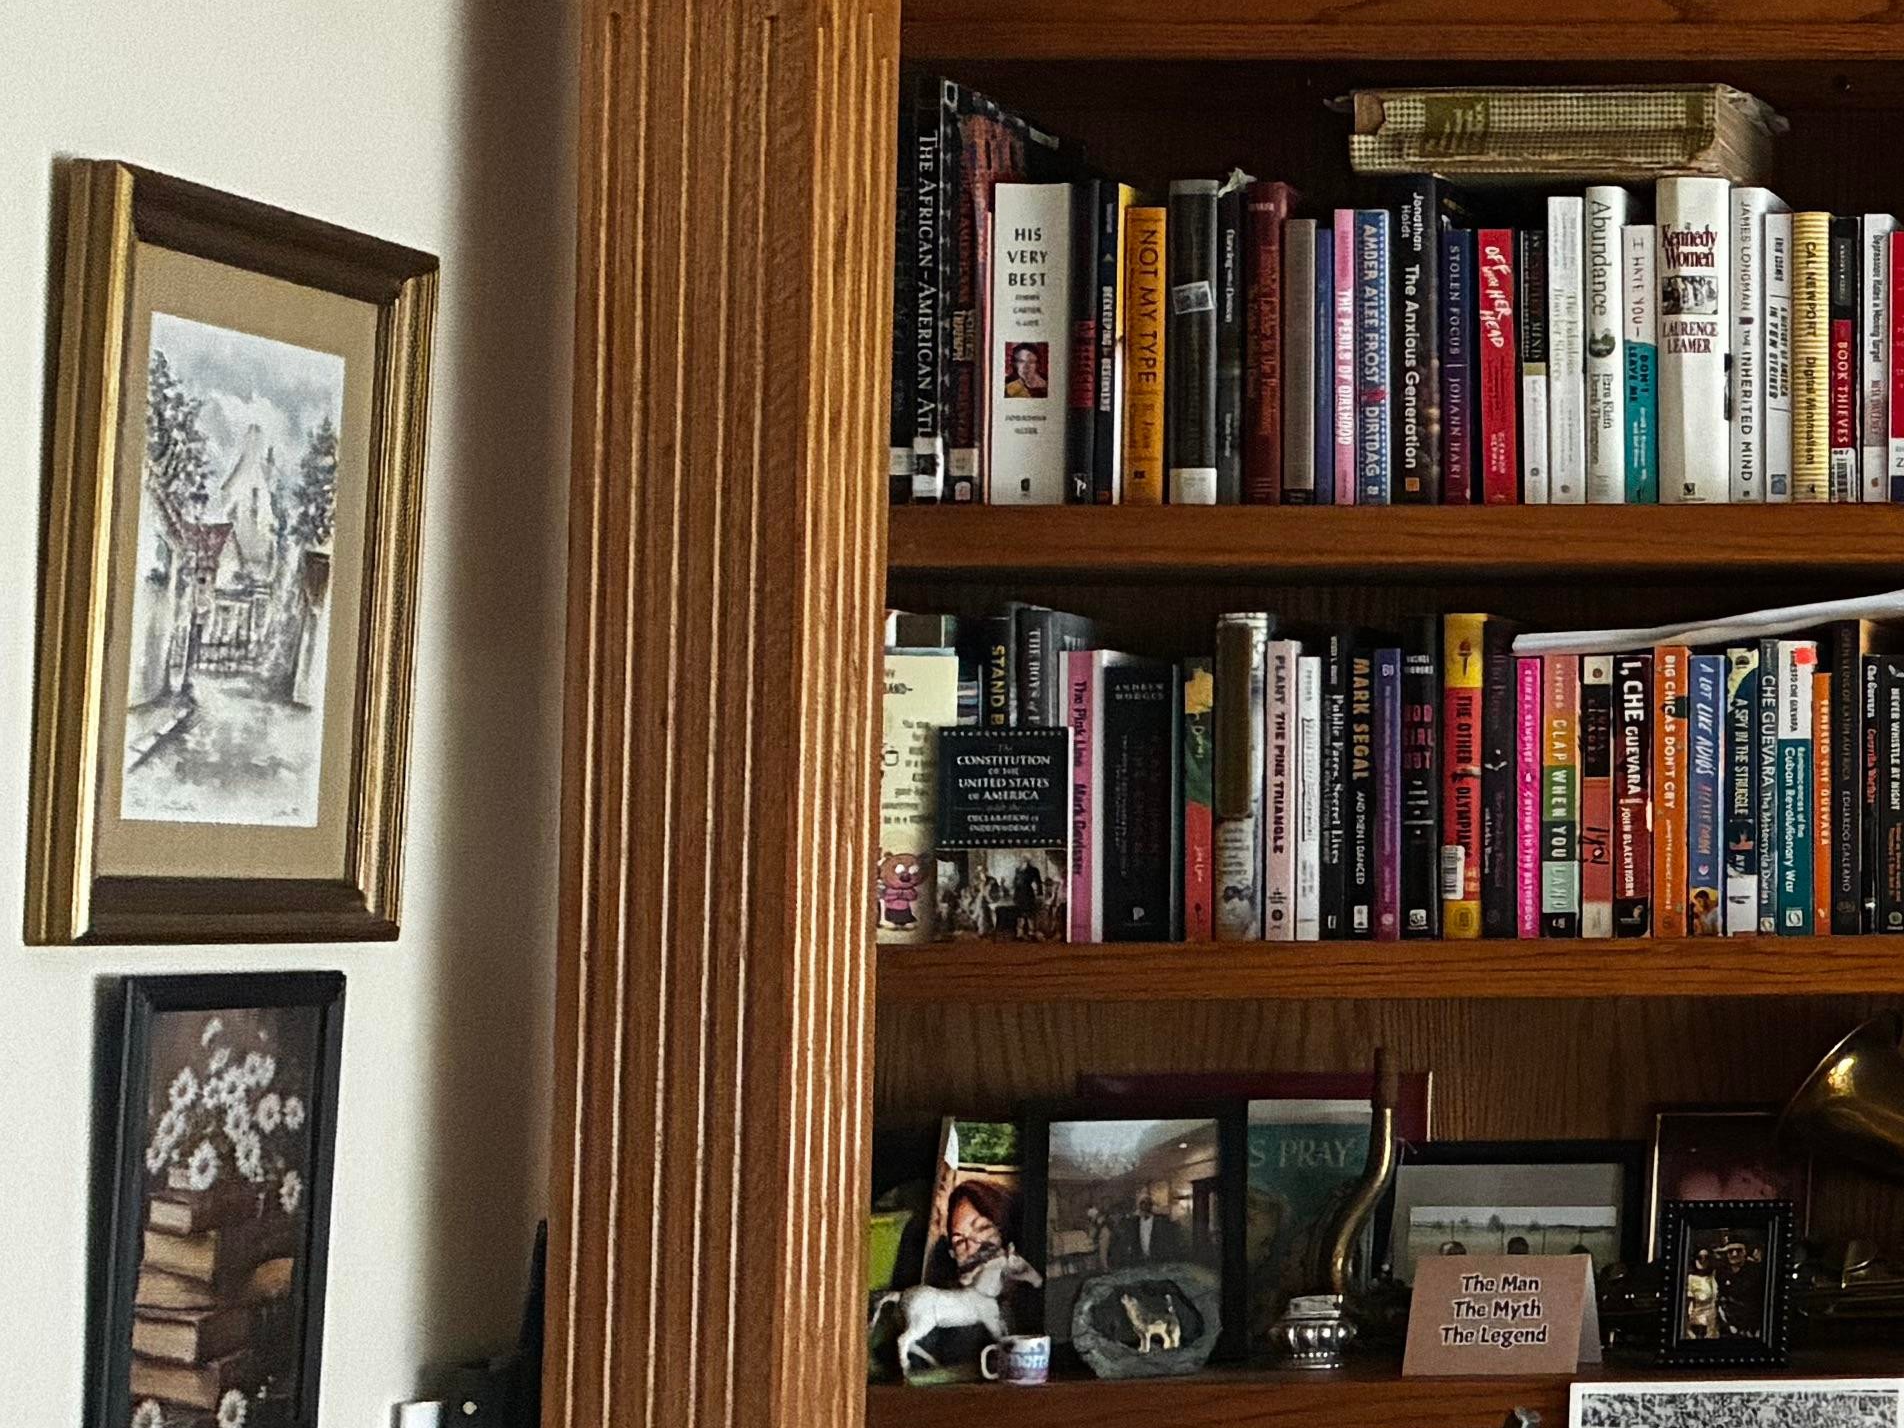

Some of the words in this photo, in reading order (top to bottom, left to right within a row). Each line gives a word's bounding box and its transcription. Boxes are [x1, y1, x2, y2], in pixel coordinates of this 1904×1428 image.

[1014, 228, 1042, 242] HIS
[1139, 230, 1157, 278] NOT
[1007, 250, 1048, 265] VERY
[1448, 246, 1461, 301] STOLEN
[1590, 200, 1612, 316] Abundance
[1008, 273, 1046, 287] BEST
[1404, 265, 1419, 296] The
[1139, 287, 1157, 320] MY
[1404, 301, 1420, 367] Anxious
[1448, 307, 1462, 355] FOCUS
[1139, 332, 1157, 384] TYPE
[1837, 342, 1849, 381] BOOK
[1740, 352, 1754, 434] INHERITED
[1404, 372, 1420, 468] Generation
[1837, 385, 1849, 443] THIEVES
[1740, 441, 1754, 481] MIND
[1354, 658, 1368, 714] MARK
[1624, 681, 1643, 722] CHE
[1762, 675, 1776, 708] CHE
[957, 756, 1051, 766] CONSTITUTION
[1353, 723, 1369, 780] SEGAL
[1626, 727, 1641, 794] GUEVARA
[1761, 712, 1776, 786] GUEVARA
[1784, 747, 1796, 786] Cuban
[1784, 789, 1797, 867] Revolutionary
[1785, 870, 1795, 893] War
[1277, 1139, 1359, 1167] PRAY
[1461, 1273, 1496, 1293] The
[1500, 1274, 1540, 1294] Man
[1453, 1299, 1487, 1319] The
[1492, 1299, 1542, 1321] Myth
[1441, 1324, 1476, 1345] The
[1480, 1325, 1548, 1348] Legend
